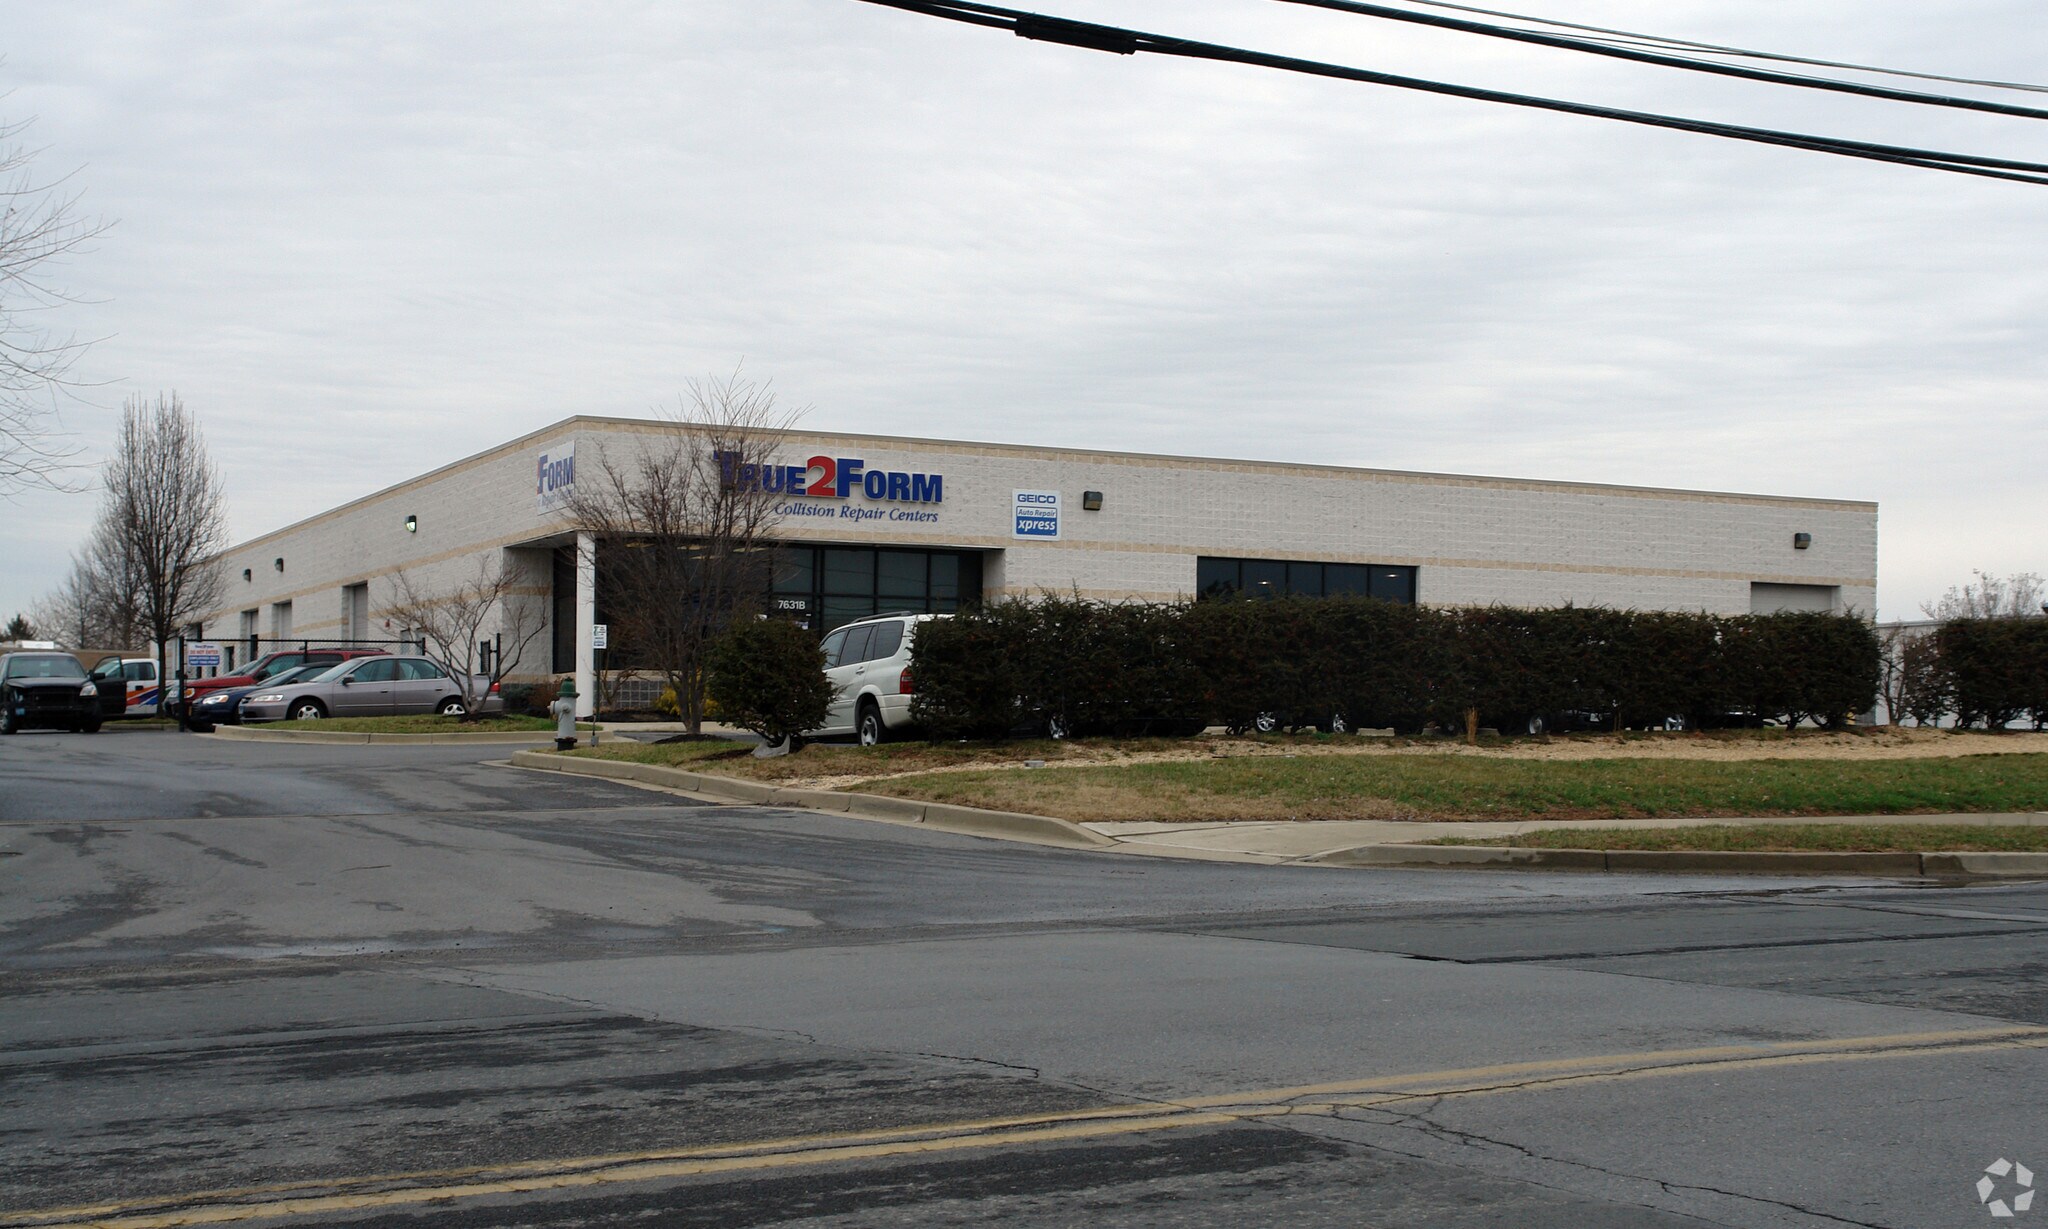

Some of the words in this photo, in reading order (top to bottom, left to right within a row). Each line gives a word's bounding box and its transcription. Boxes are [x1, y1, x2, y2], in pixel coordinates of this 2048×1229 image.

[536, 454, 574, 496] FORM
[713, 450, 943, 503] TRUE2FORM
[1017, 493, 1056, 504] GEICO
[774, 501, 835, 517] Collision
[839, 505, 885, 522] Repair
[889, 508, 939, 522] Centers
[1034, 510, 1056, 518] Repair
[1018, 520, 1056, 532] xpress
[778, 600, 806, 610] 7631B
